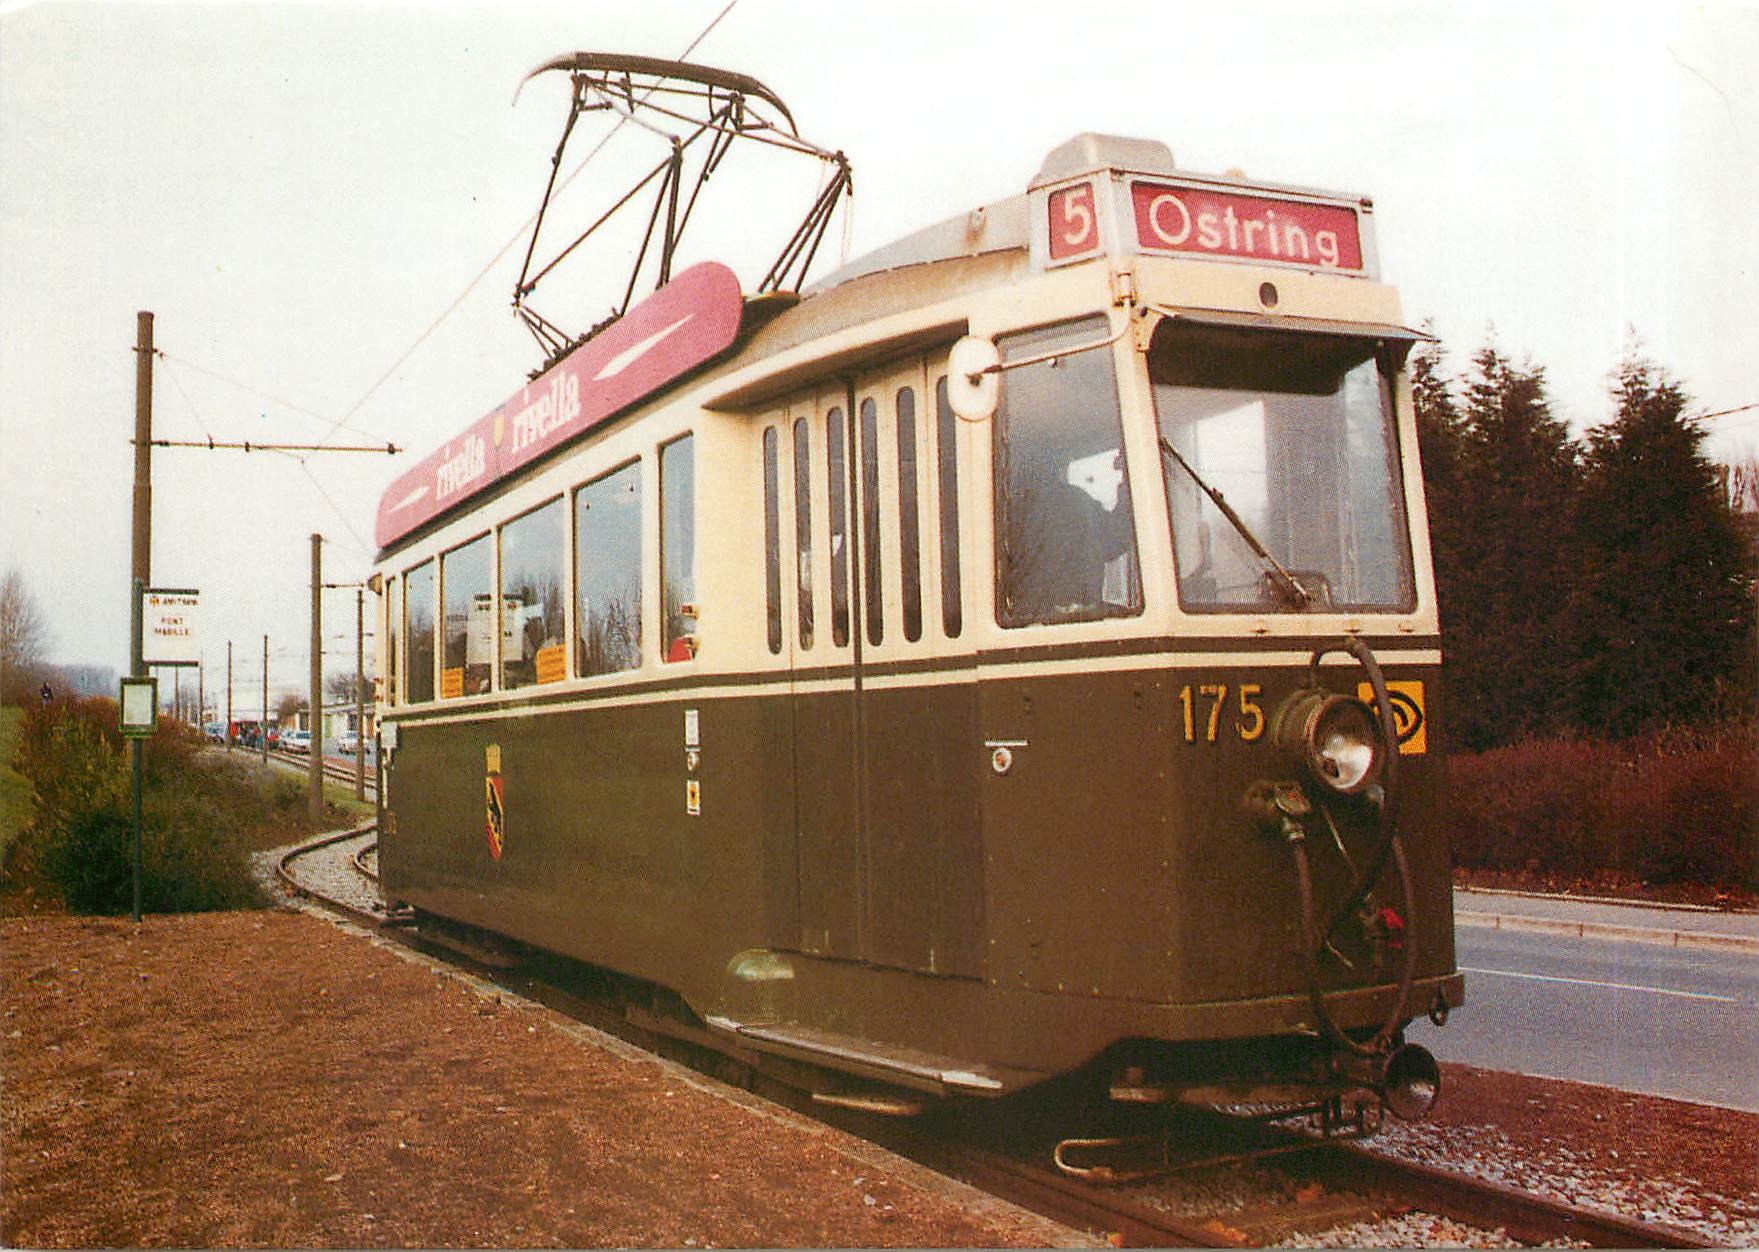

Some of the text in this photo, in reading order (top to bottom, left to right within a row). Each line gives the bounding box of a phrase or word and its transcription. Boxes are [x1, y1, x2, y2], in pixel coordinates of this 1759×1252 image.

[1063, 189, 1341, 268] 5 Ostring
[1179, 684, 1265, 742] 175
